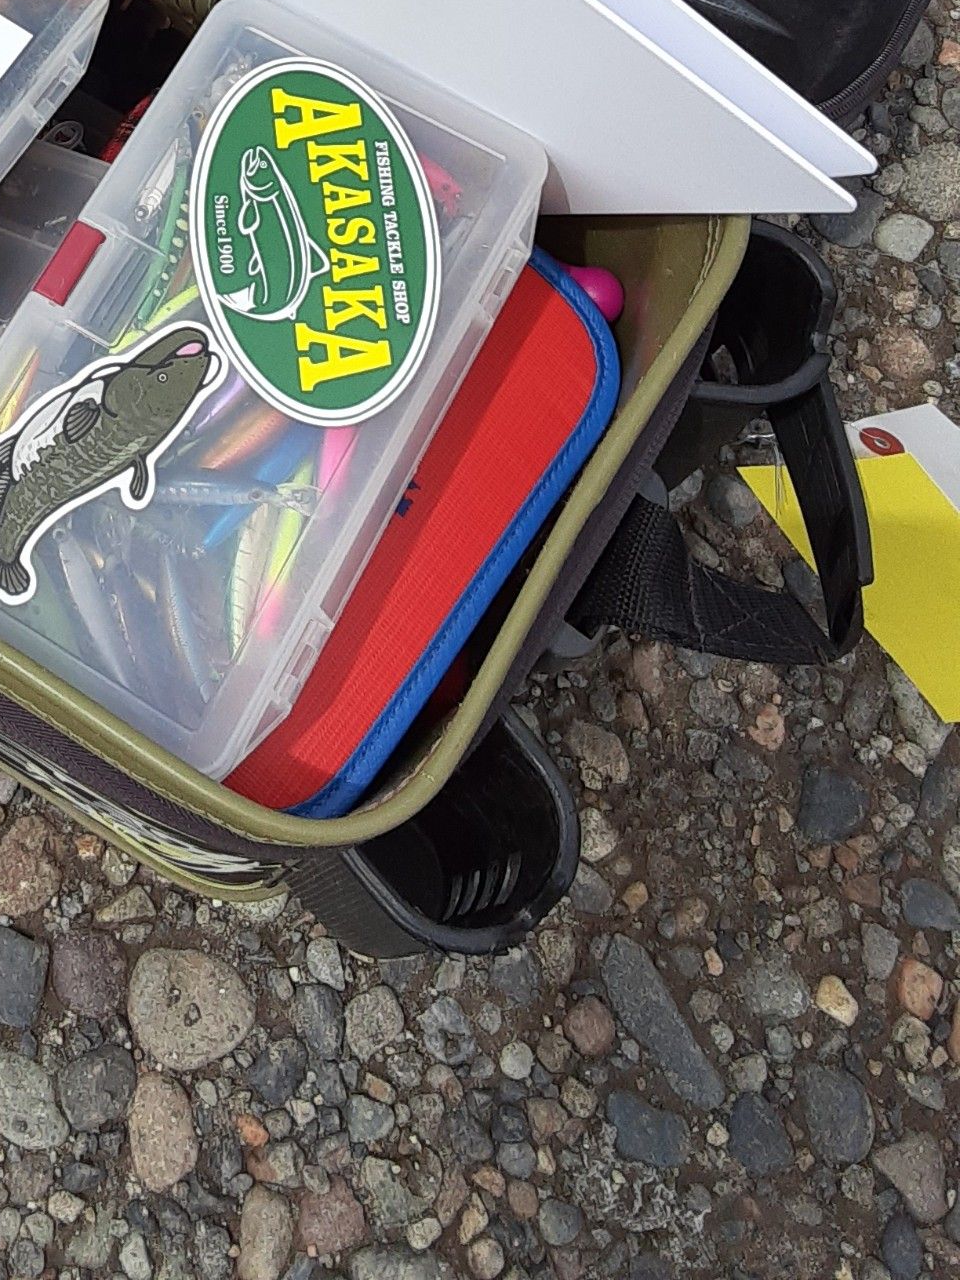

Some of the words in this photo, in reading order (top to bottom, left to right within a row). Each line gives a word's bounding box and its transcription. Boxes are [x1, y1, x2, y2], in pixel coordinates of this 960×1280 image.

[374, 140, 395, 208] FISHING
[270, 87, 392, 393] AKASAKA
[382, 210, 405, 275] TACKLE
[392, 279, 411, 325] SHOP
